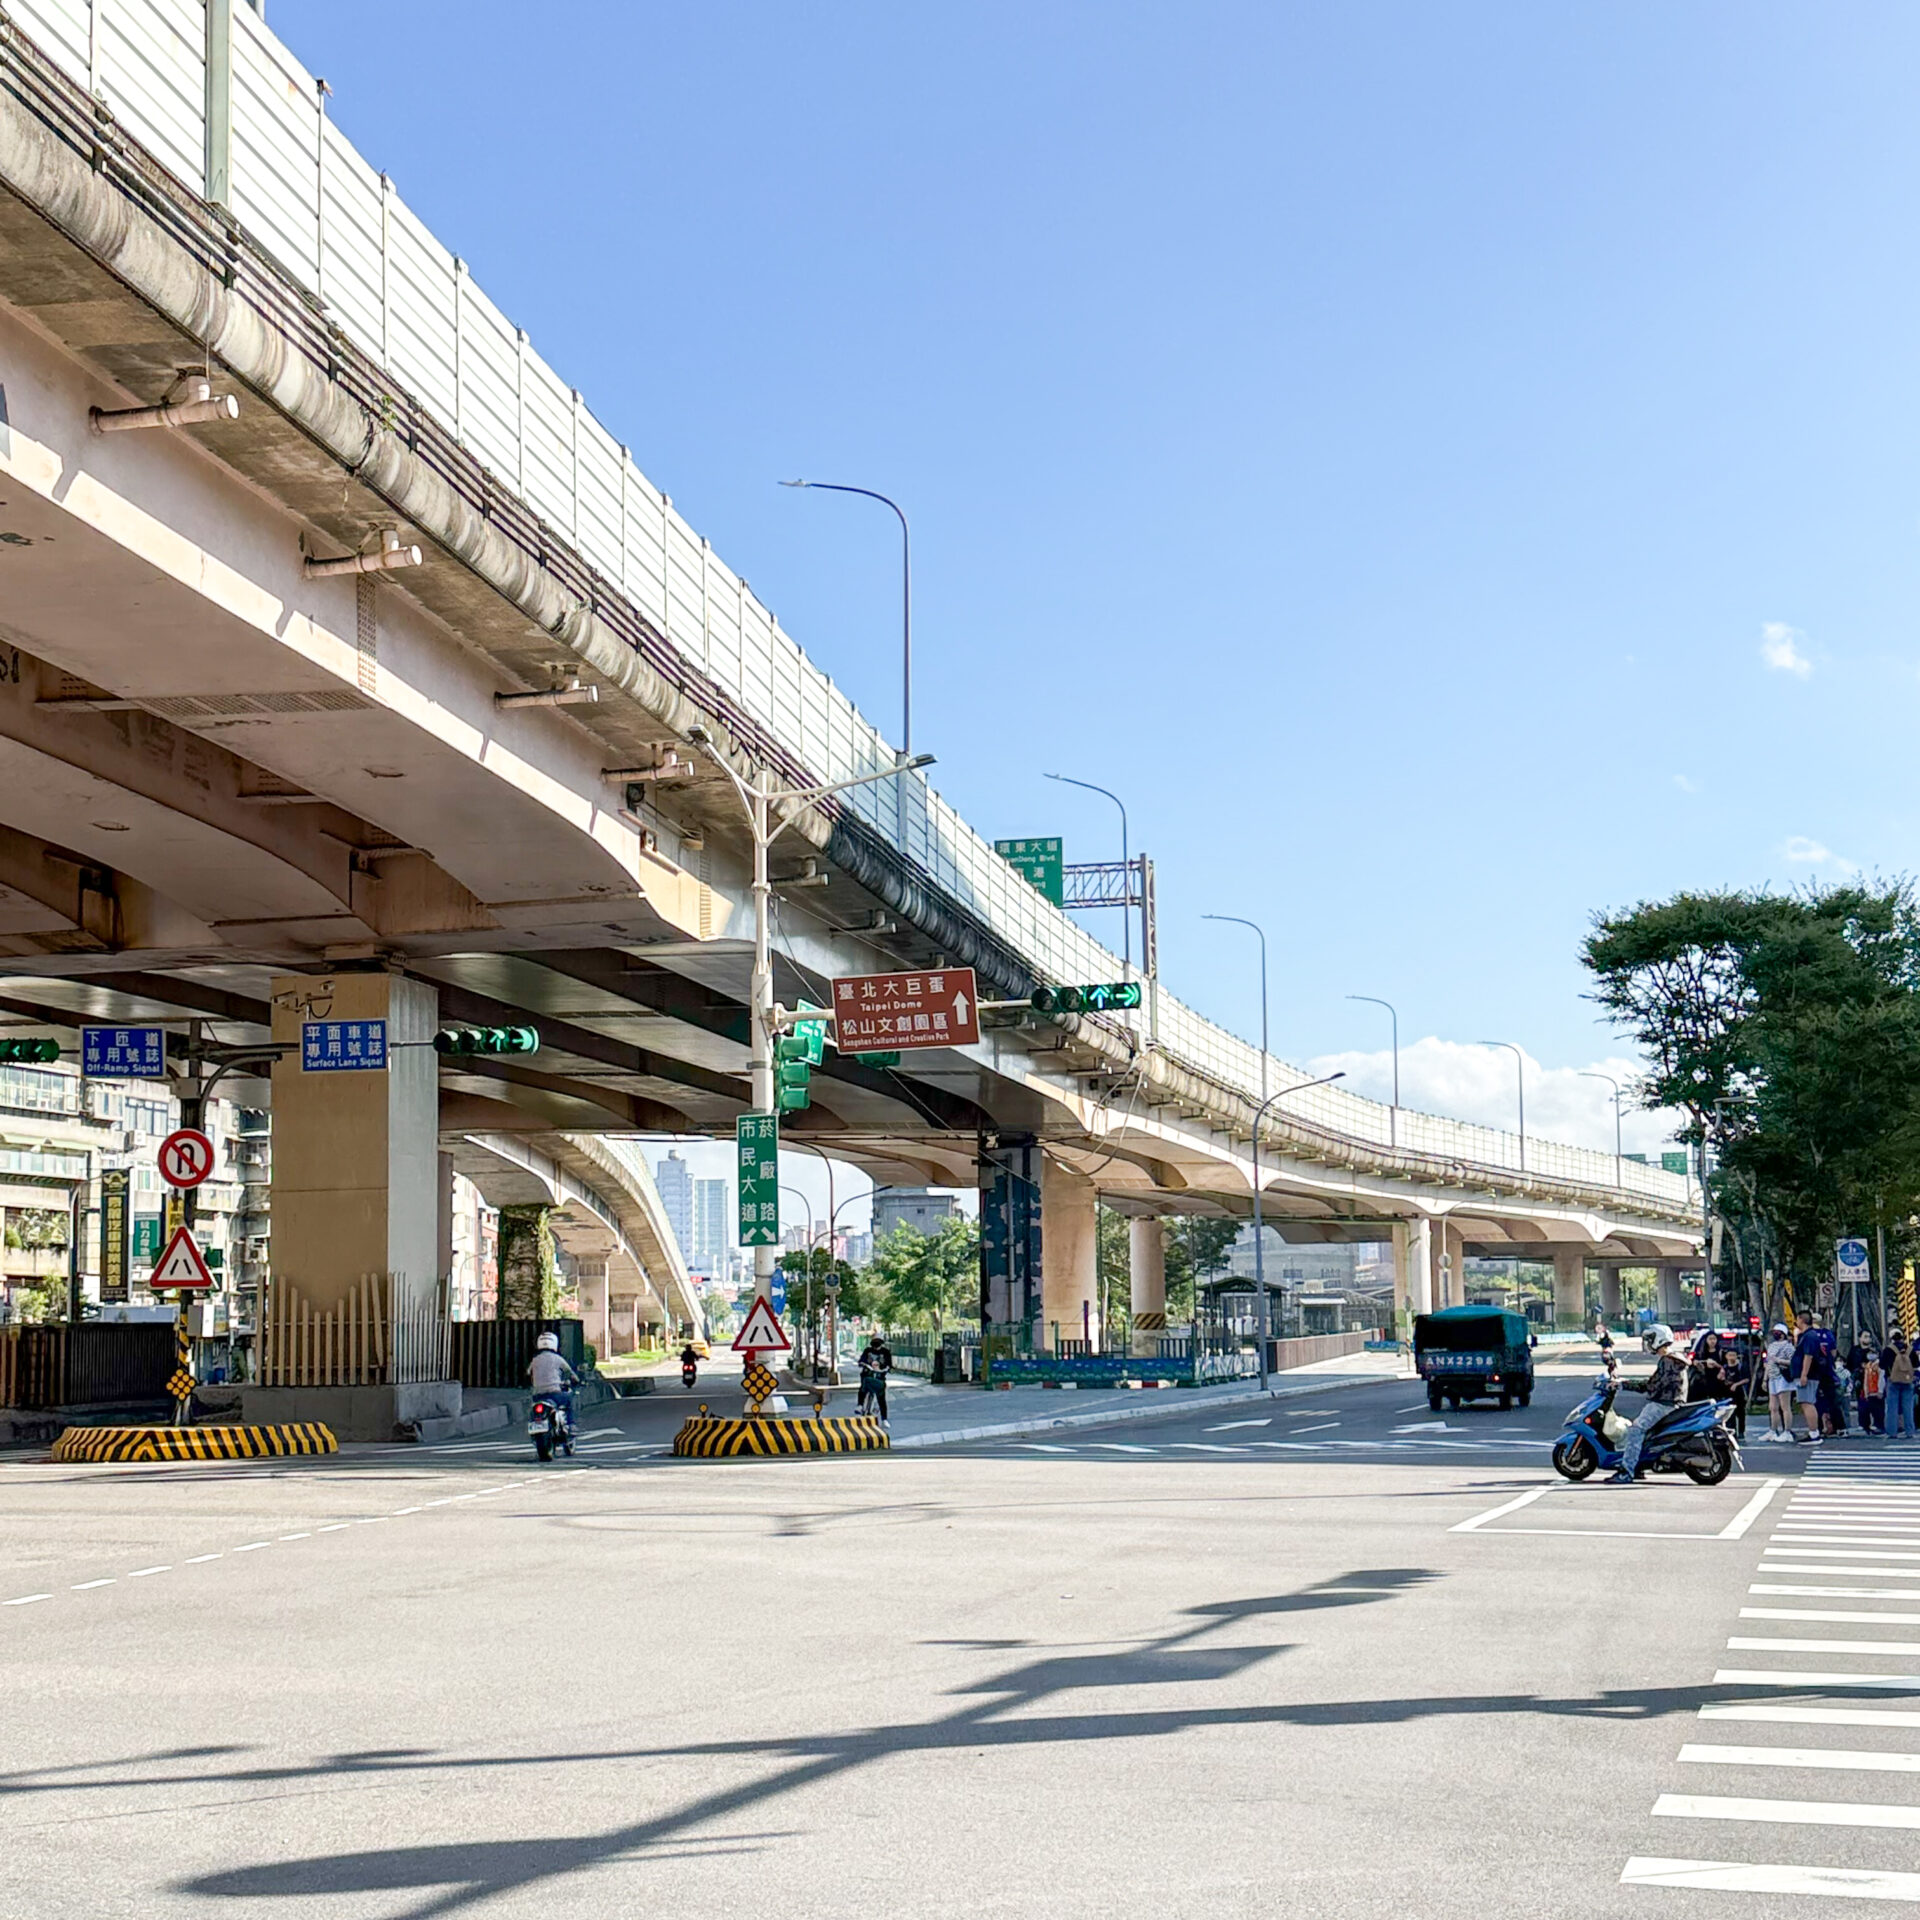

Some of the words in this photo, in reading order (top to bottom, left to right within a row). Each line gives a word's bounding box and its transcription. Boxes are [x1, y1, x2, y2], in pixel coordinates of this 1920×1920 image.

[838, 976, 945, 1000] 臺北大巨蛋
[860, 1001, 891, 1012] Taipei
[893, 1001, 922, 1009] Dome
[842, 1012, 948, 1035] 松山文創園區
[86, 1031, 159, 1047] 下匝道
[306, 1024, 382, 1041] 平面車道
[873, 1035, 898, 1045] Cultural
[898, 1034, 909, 1043] and
[910, 1033, 934, 1043] Creative
[935, 1031, 950, 1040] Park
[86, 1047, 160, 1063] 專用號誌
[306, 1041, 382, 1058] 專用號誌
[86, 1063, 130, 1073] Off-Ramp
[132, 1063, 160, 1074] Signal
[306, 1058, 336, 1068] Surface
[338, 1058, 357, 1067] Lane
[360, 1057, 383, 1067] Signal
[741, 1120, 757, 1222] 市民大道
[758, 1119, 776, 1221] 菸廠路
